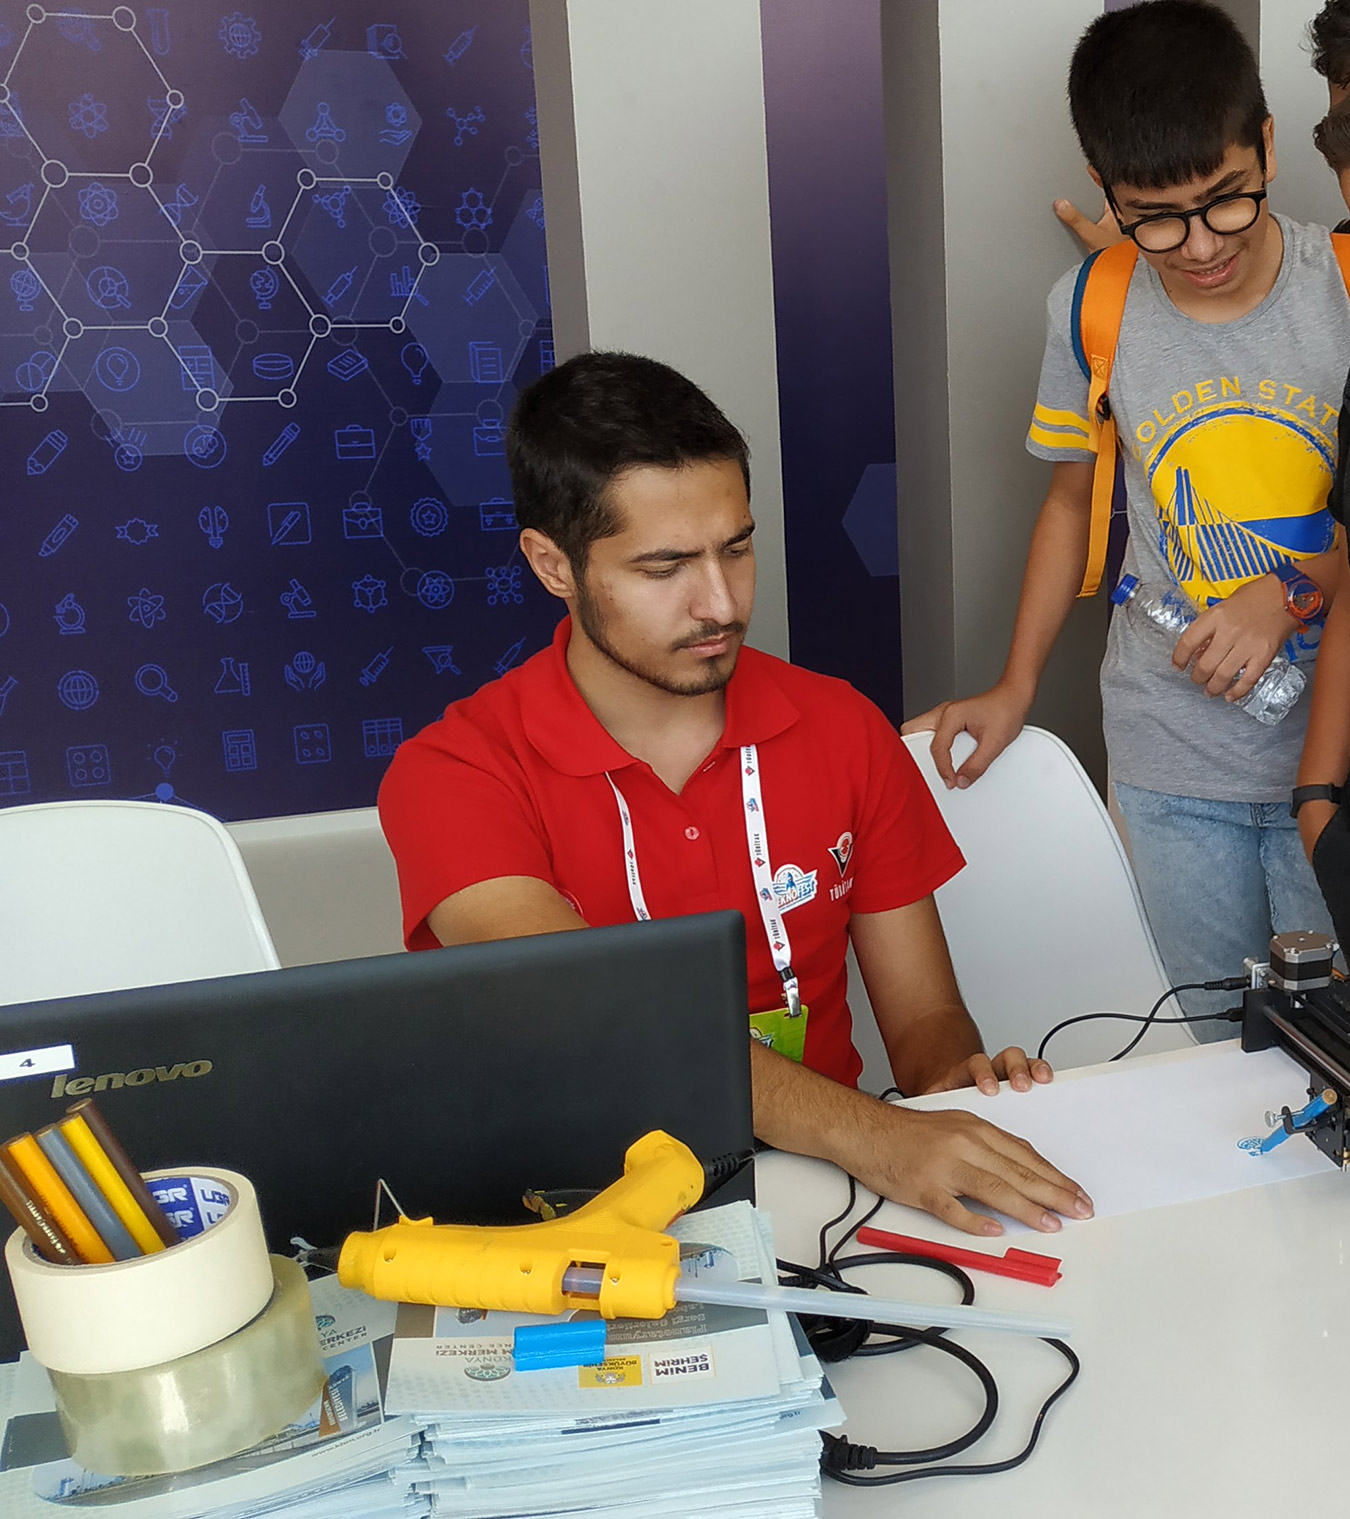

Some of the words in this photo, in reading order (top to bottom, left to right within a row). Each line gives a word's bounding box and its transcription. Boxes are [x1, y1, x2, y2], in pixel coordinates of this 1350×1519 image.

[1258, 379, 1340, 438] STAT
[19, 1058, 36, 1069] 4
[50, 1060, 213, 1099] lenovo
